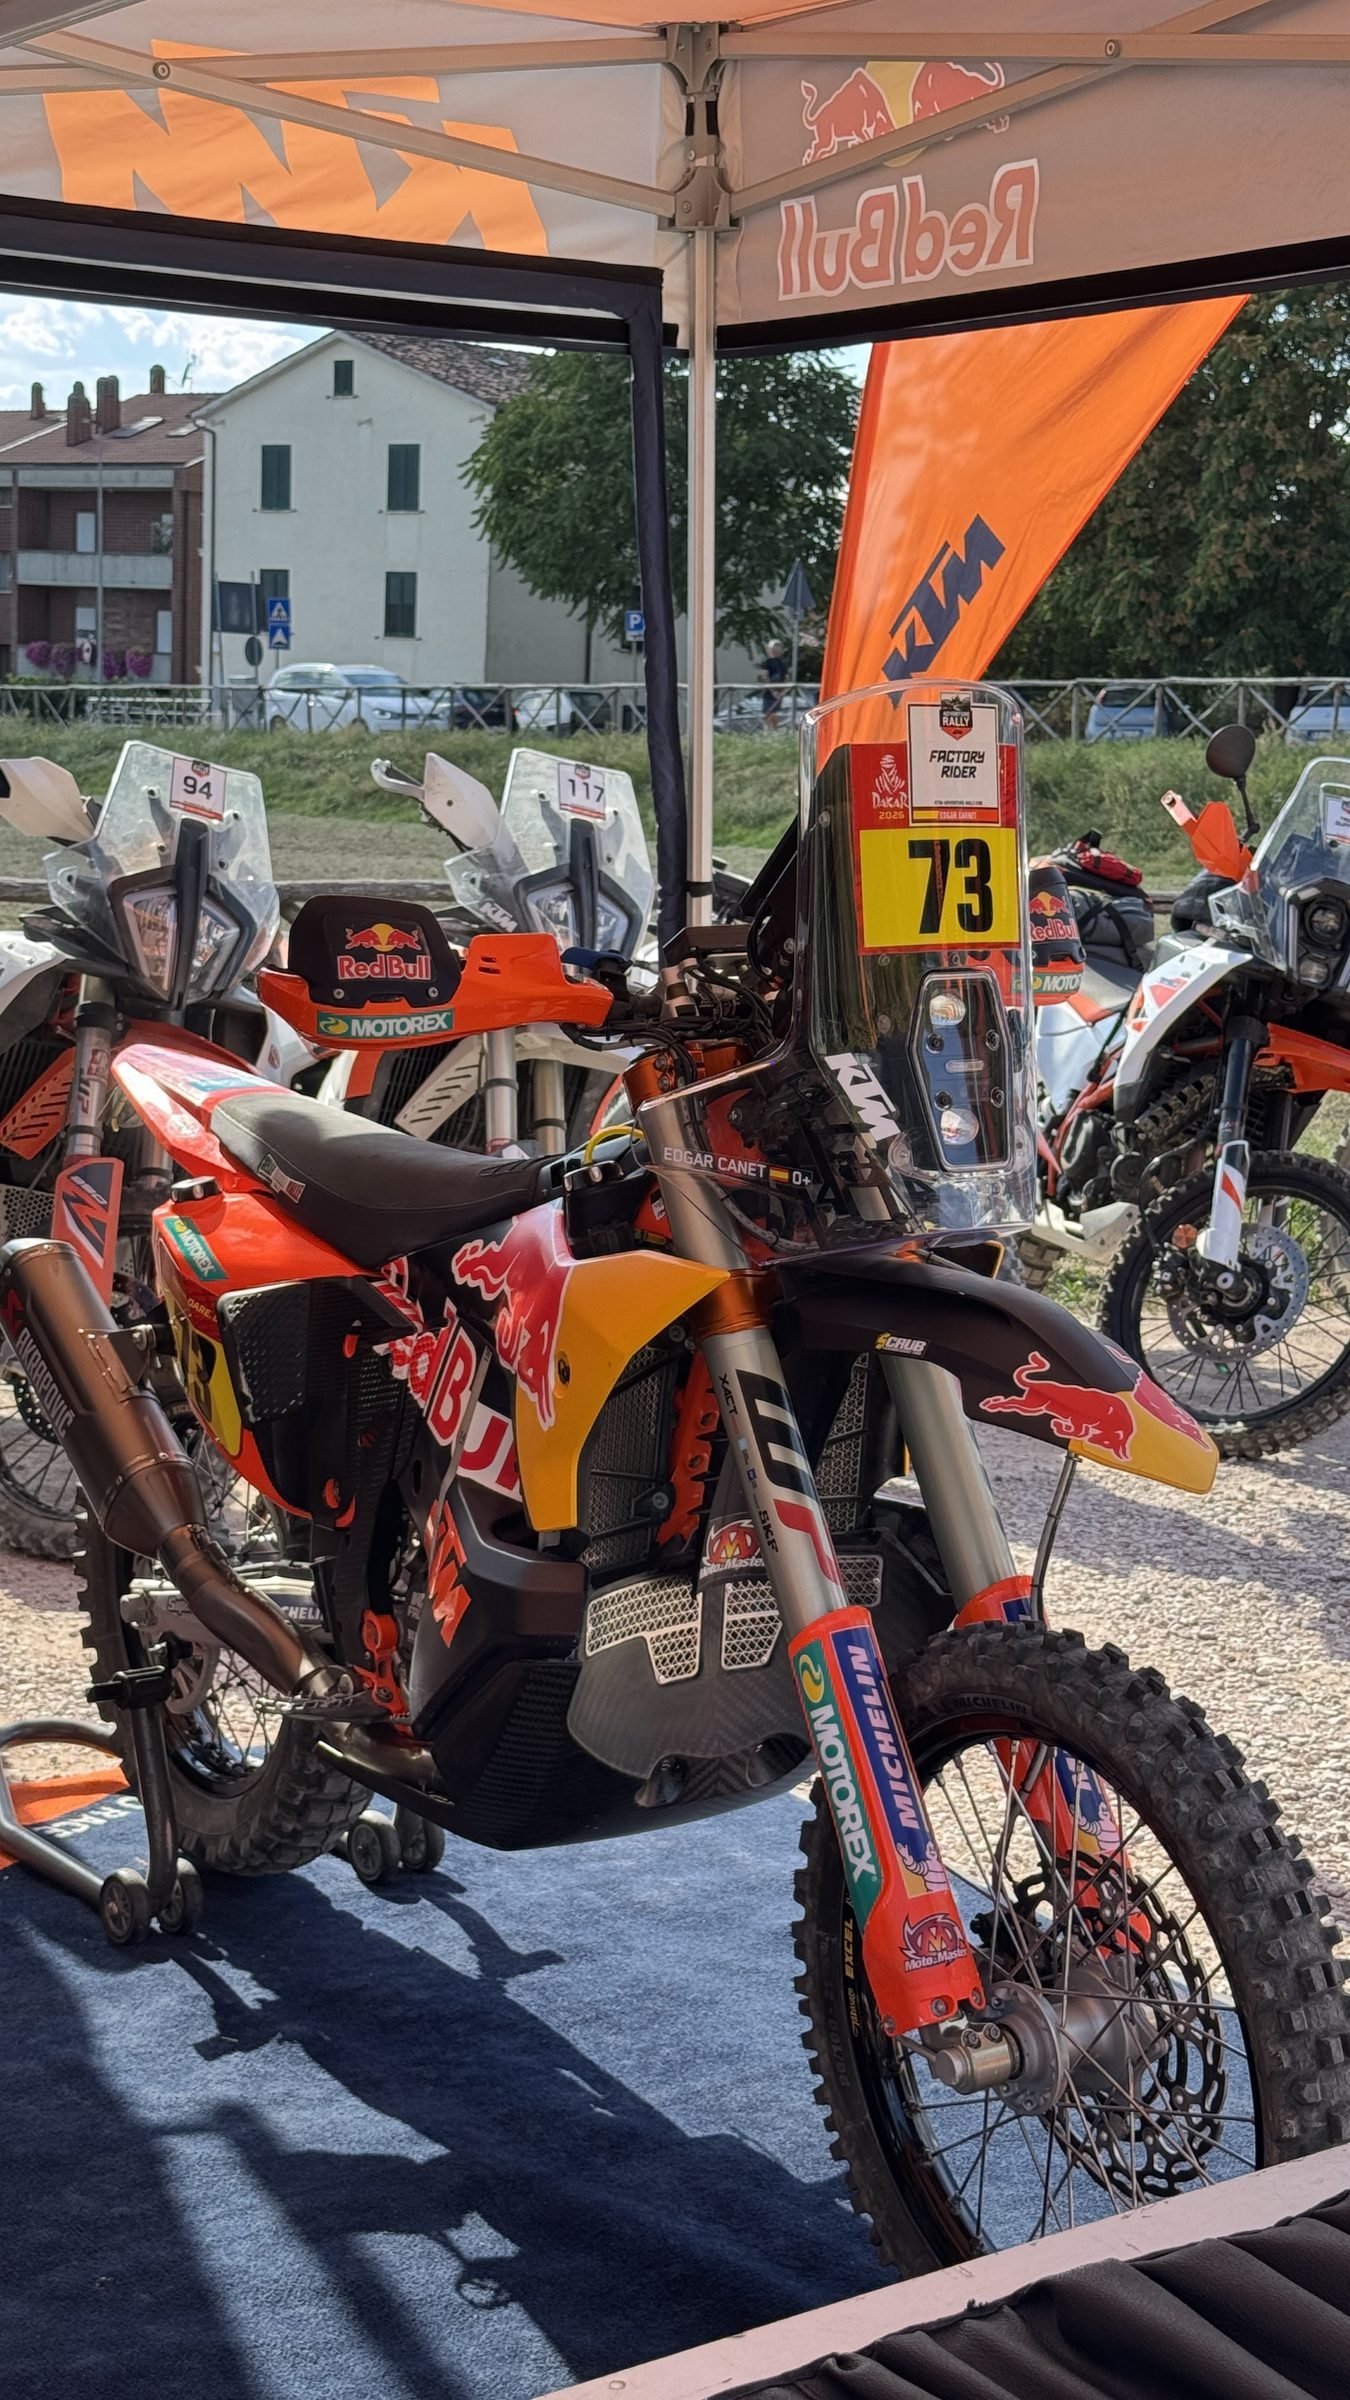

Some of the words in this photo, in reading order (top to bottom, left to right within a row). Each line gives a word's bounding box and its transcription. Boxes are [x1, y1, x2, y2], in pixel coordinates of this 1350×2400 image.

[629, 613, 642, 630] P
[881, 514, 1006, 710] KTM
[942, 716, 970, 727] RALLY
[929, 750, 985, 764] FACTORY
[941, 765, 977, 779] RIDER
[183, 776, 213, 800] 94
[568, 778, 604, 803] 117
[878, 811, 905, 820] 2026
[908, 838, 993, 934] 73
[480, 902, 519, 933] KTM
[351, 1013, 450, 1038] MOTOREX
[824, 1052, 901, 1142] KTM
[663, 1146, 714, 1169] EDGAR
[717, 1156, 767, 1179] CANET
[180, 1229, 216, 1278] MOTOREX
[875, 1332, 927, 1352] SCRUB
[719, 1373, 738, 1416] XACT
[759, 1509, 779, 1553] SKF
[424, 1499, 472, 1649] KTM
[282, 1605, 324, 1621] CHELI
[847, 1644, 920, 1831] MICHELIN
[810, 1703, 878, 1884] MOTOREX
[844, 1918, 854, 1980] EXCEL
